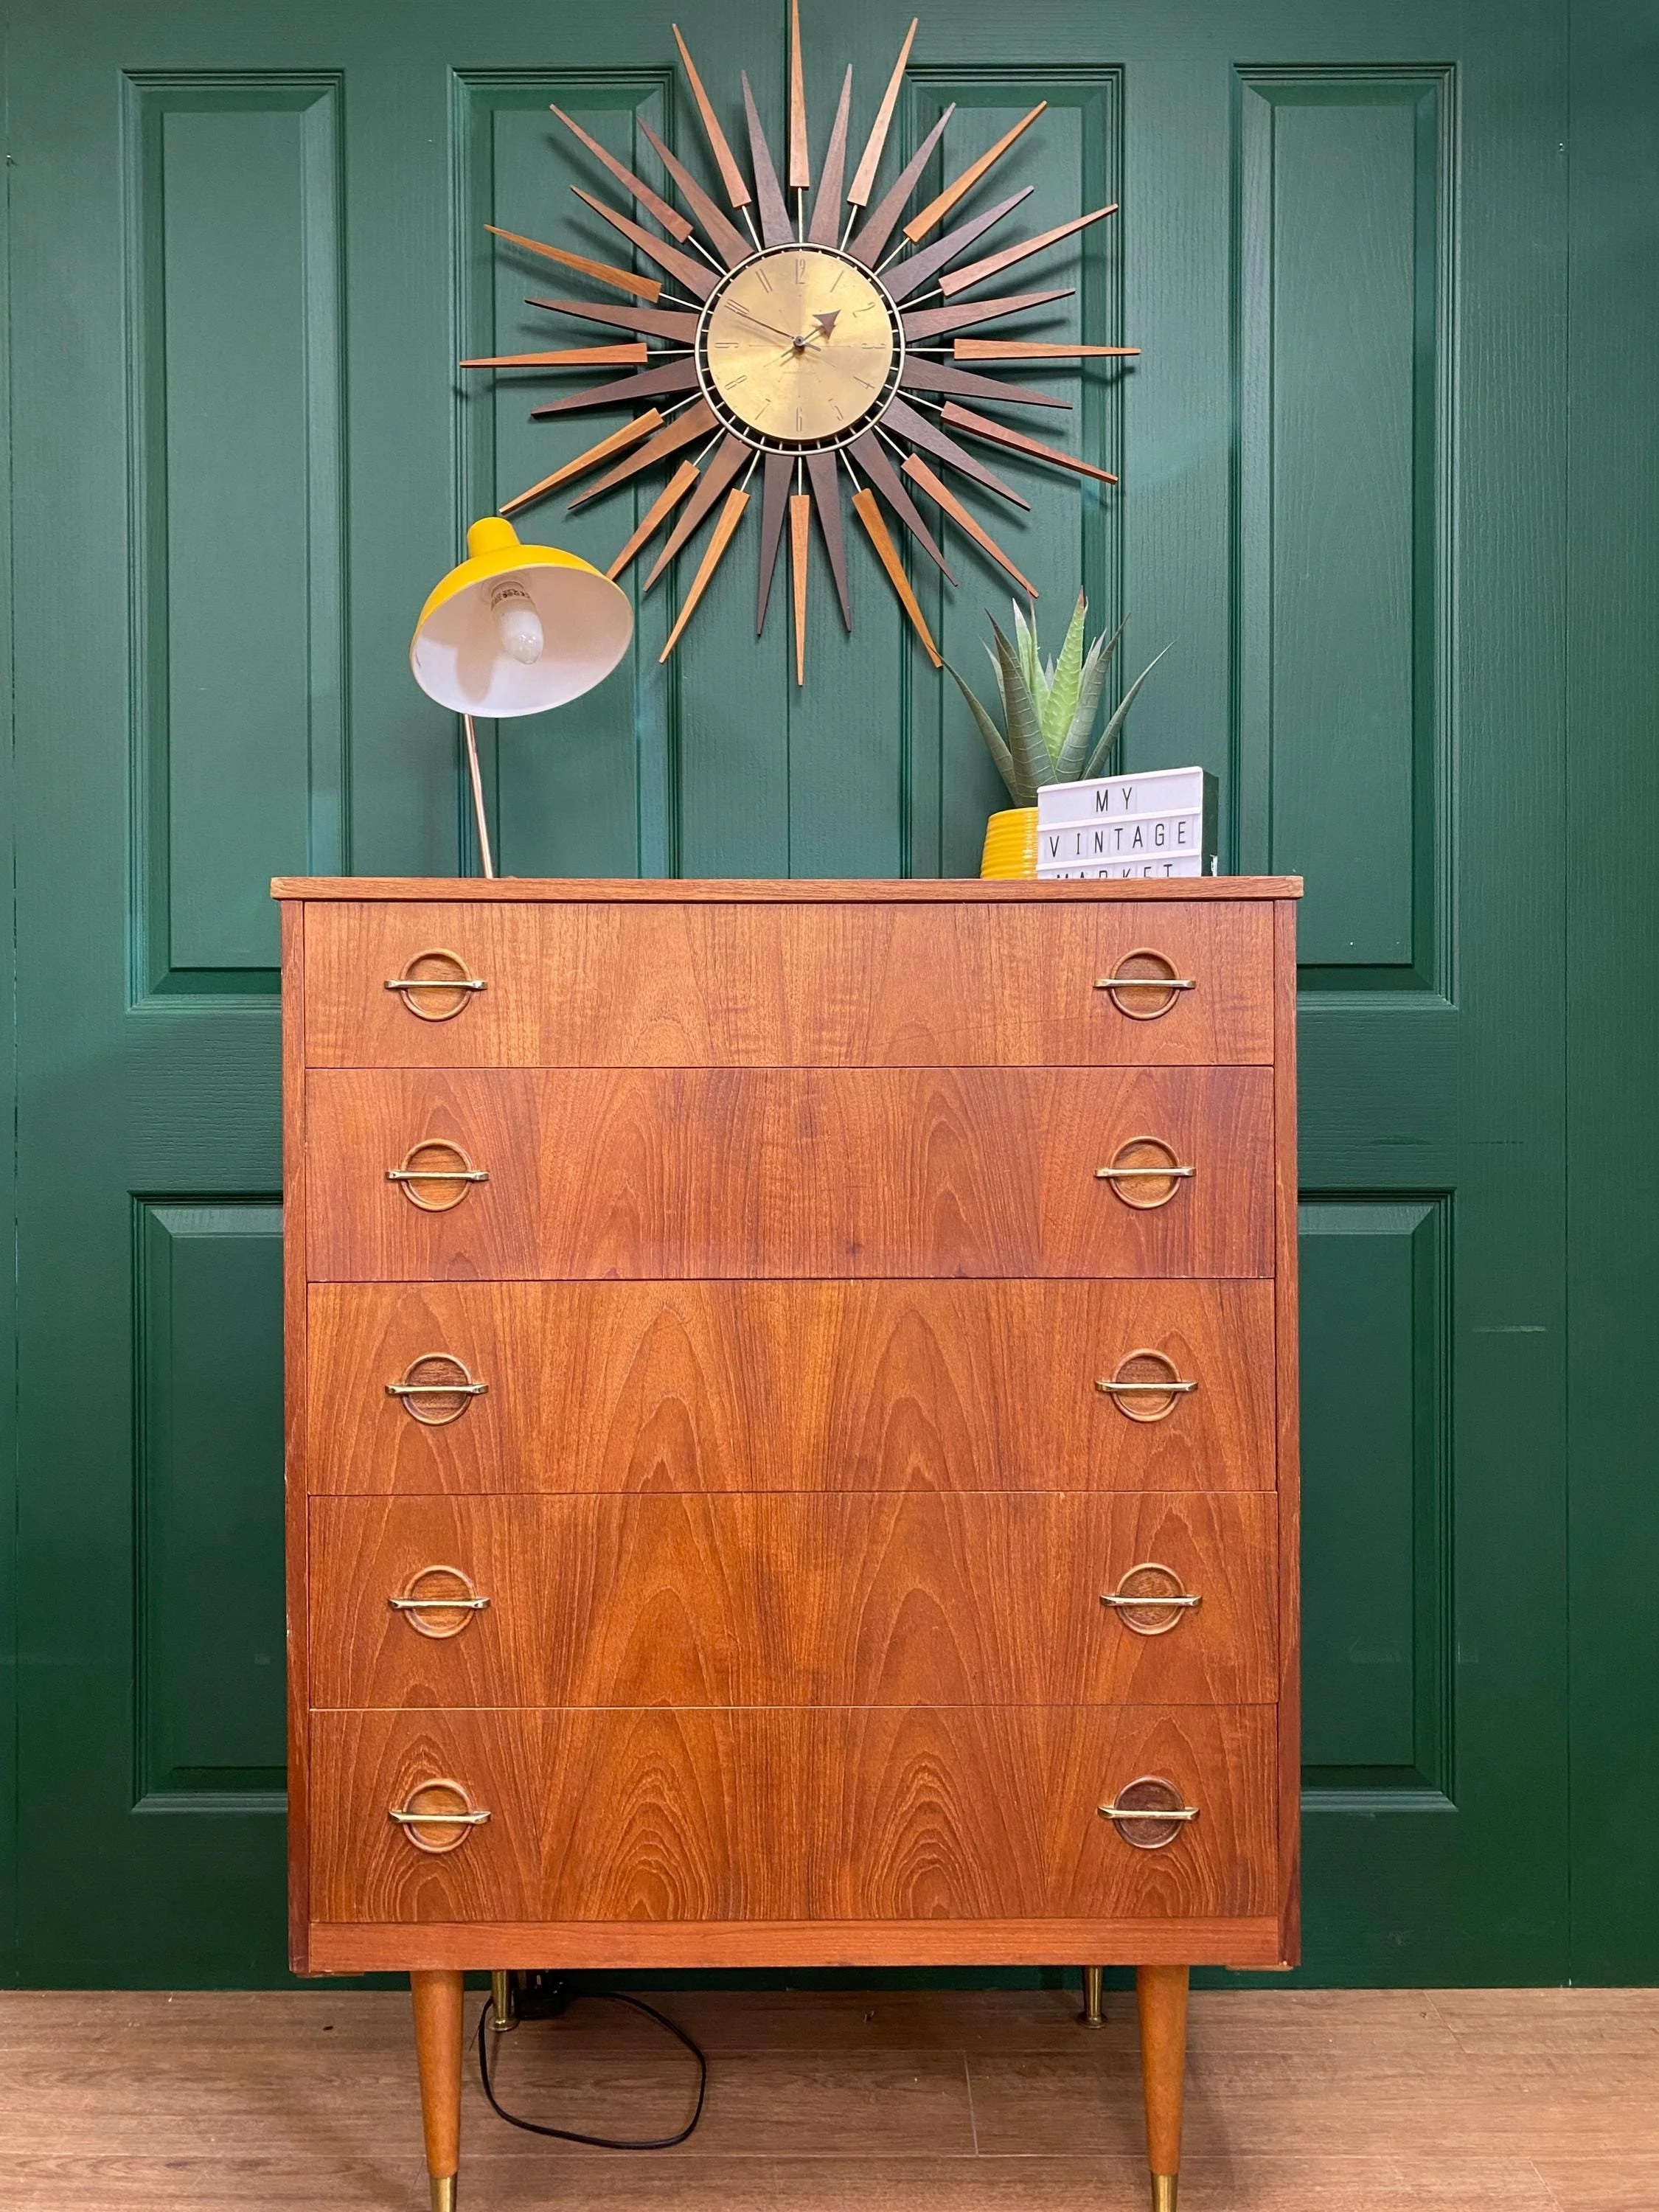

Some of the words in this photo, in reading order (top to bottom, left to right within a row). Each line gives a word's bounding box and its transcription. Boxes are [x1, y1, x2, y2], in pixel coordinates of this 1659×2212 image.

[795, 259, 805, 285] 12
[852, 302, 875, 318] 2
[724, 375, 747, 390] 8
[853, 376, 875, 390] 4
[754, 398, 771, 420] 7
[796, 406, 802, 432] 6
[828, 398, 844, 421] 5
[1096, 787, 1133, 813] MY
[1049, 821, 1186, 858] VINTAGE
